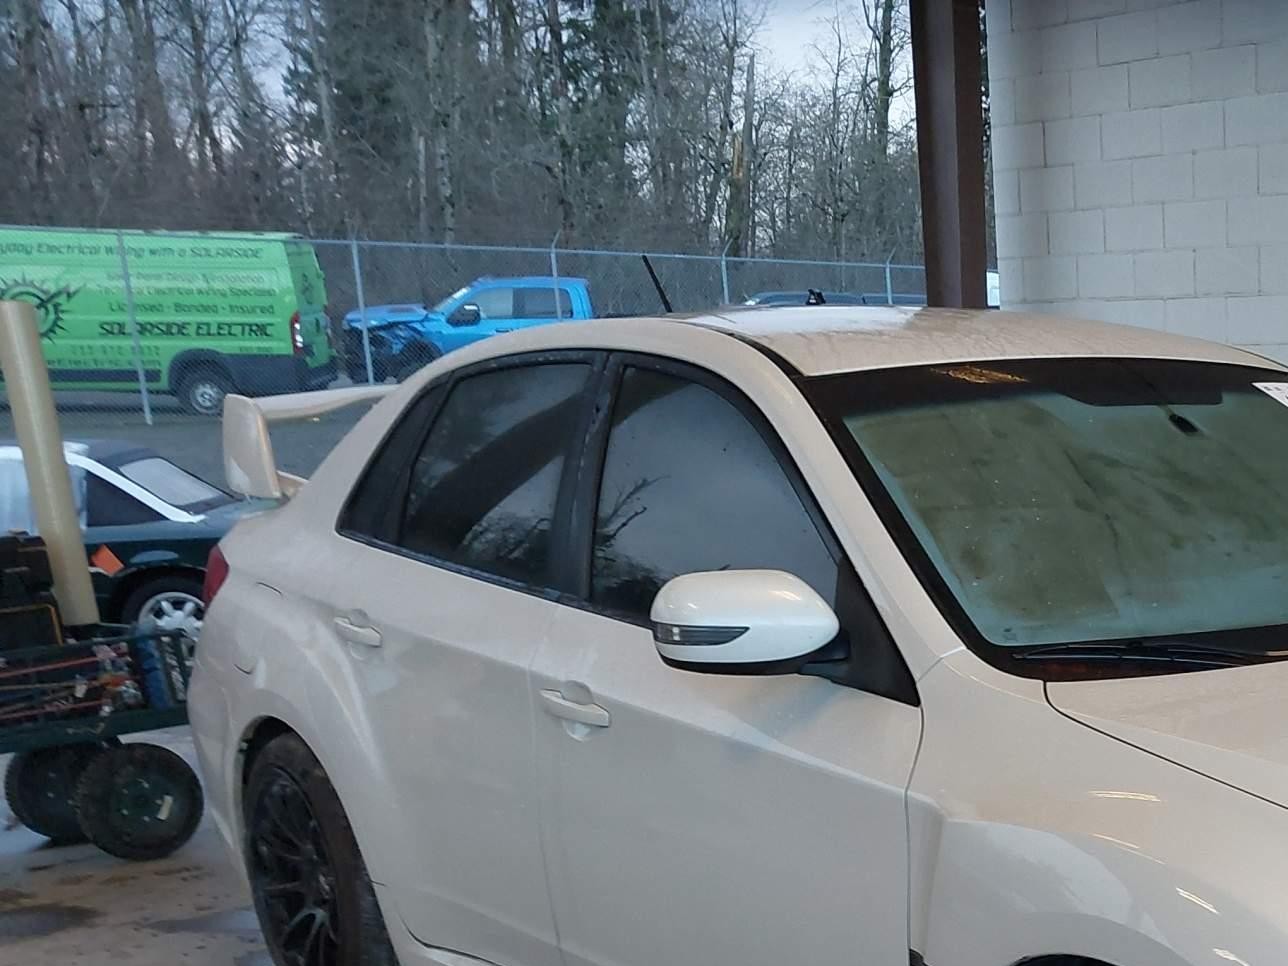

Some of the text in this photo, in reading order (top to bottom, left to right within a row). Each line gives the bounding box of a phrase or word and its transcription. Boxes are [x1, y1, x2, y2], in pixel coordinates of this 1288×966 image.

[37, 243, 98, 255] Electrical
[228, 303, 275, 315] Insured
[196, 321, 275, 337] ELECTRIC
